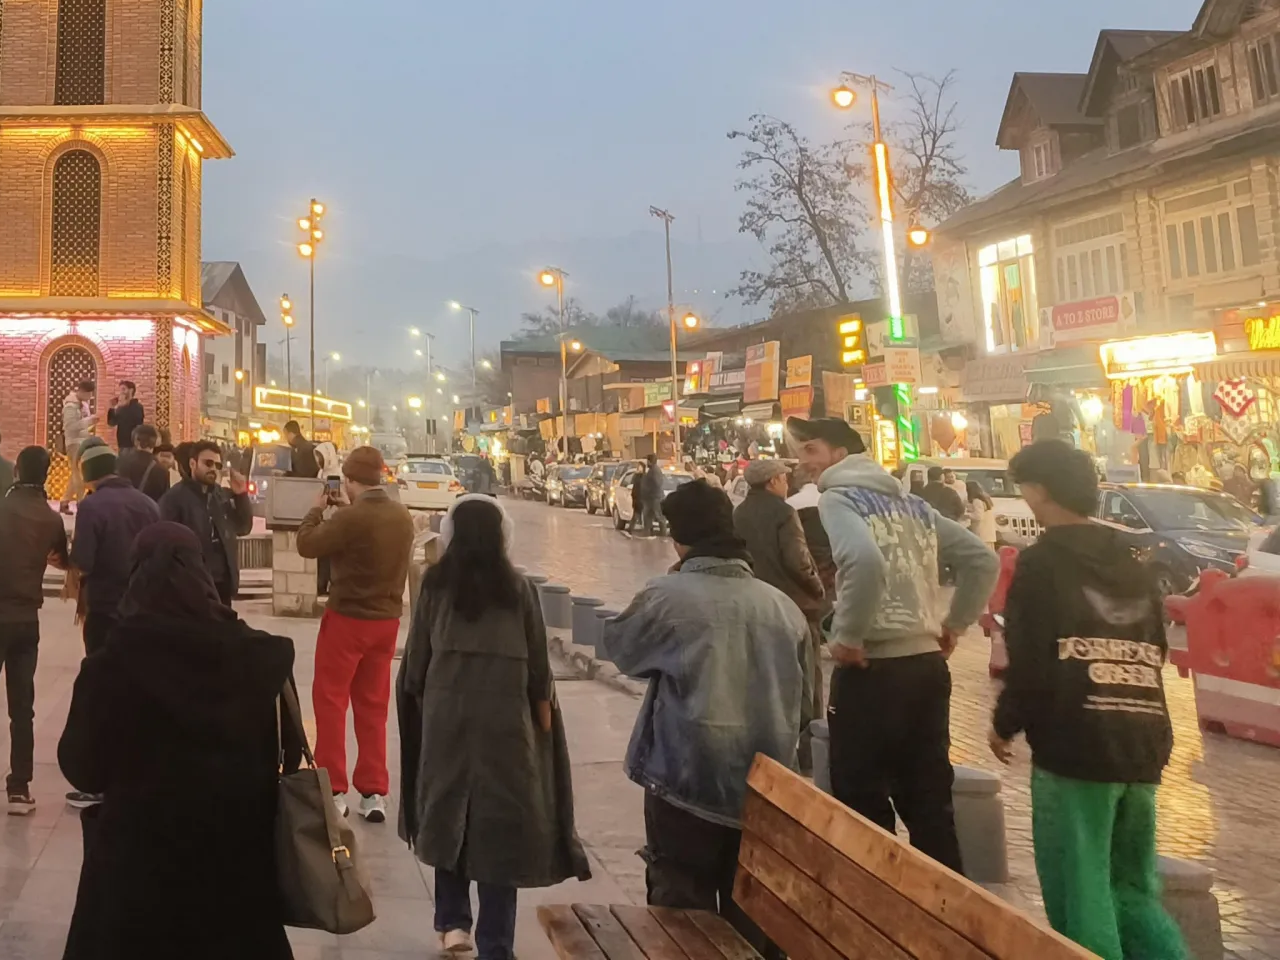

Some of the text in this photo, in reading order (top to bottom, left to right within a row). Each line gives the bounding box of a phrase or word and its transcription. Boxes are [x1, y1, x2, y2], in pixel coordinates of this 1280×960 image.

[1063, 312, 1076, 325] TO
[1084, 305, 1115, 322] STORE
[853, 407, 862, 420] P
